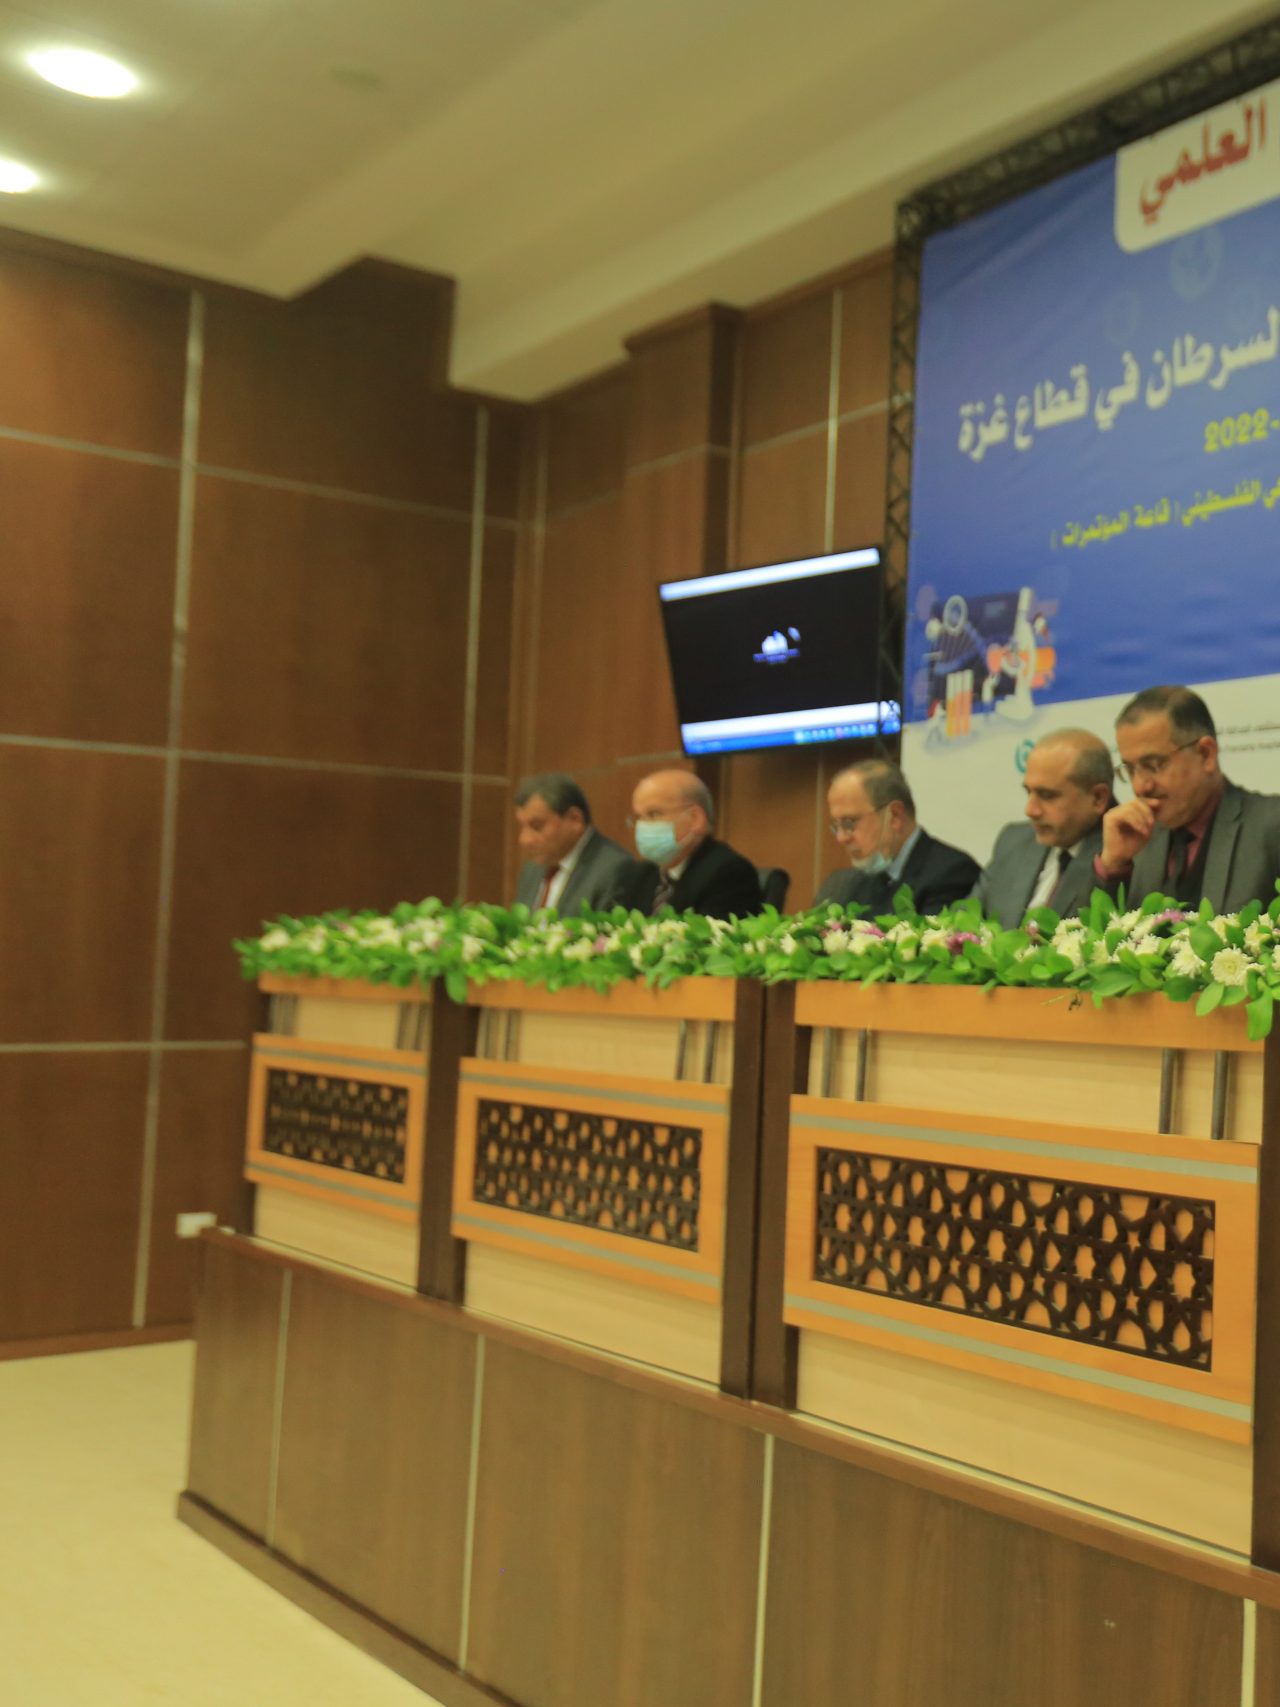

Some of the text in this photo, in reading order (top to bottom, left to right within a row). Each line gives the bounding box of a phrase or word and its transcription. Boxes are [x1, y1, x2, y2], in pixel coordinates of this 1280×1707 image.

[1139, 95, 1267, 226] العلمي
[957, 392, 1010, 464] غزة
[1013, 363, 1091, 452] قطاع
[1094, 350, 1141, 432] في
